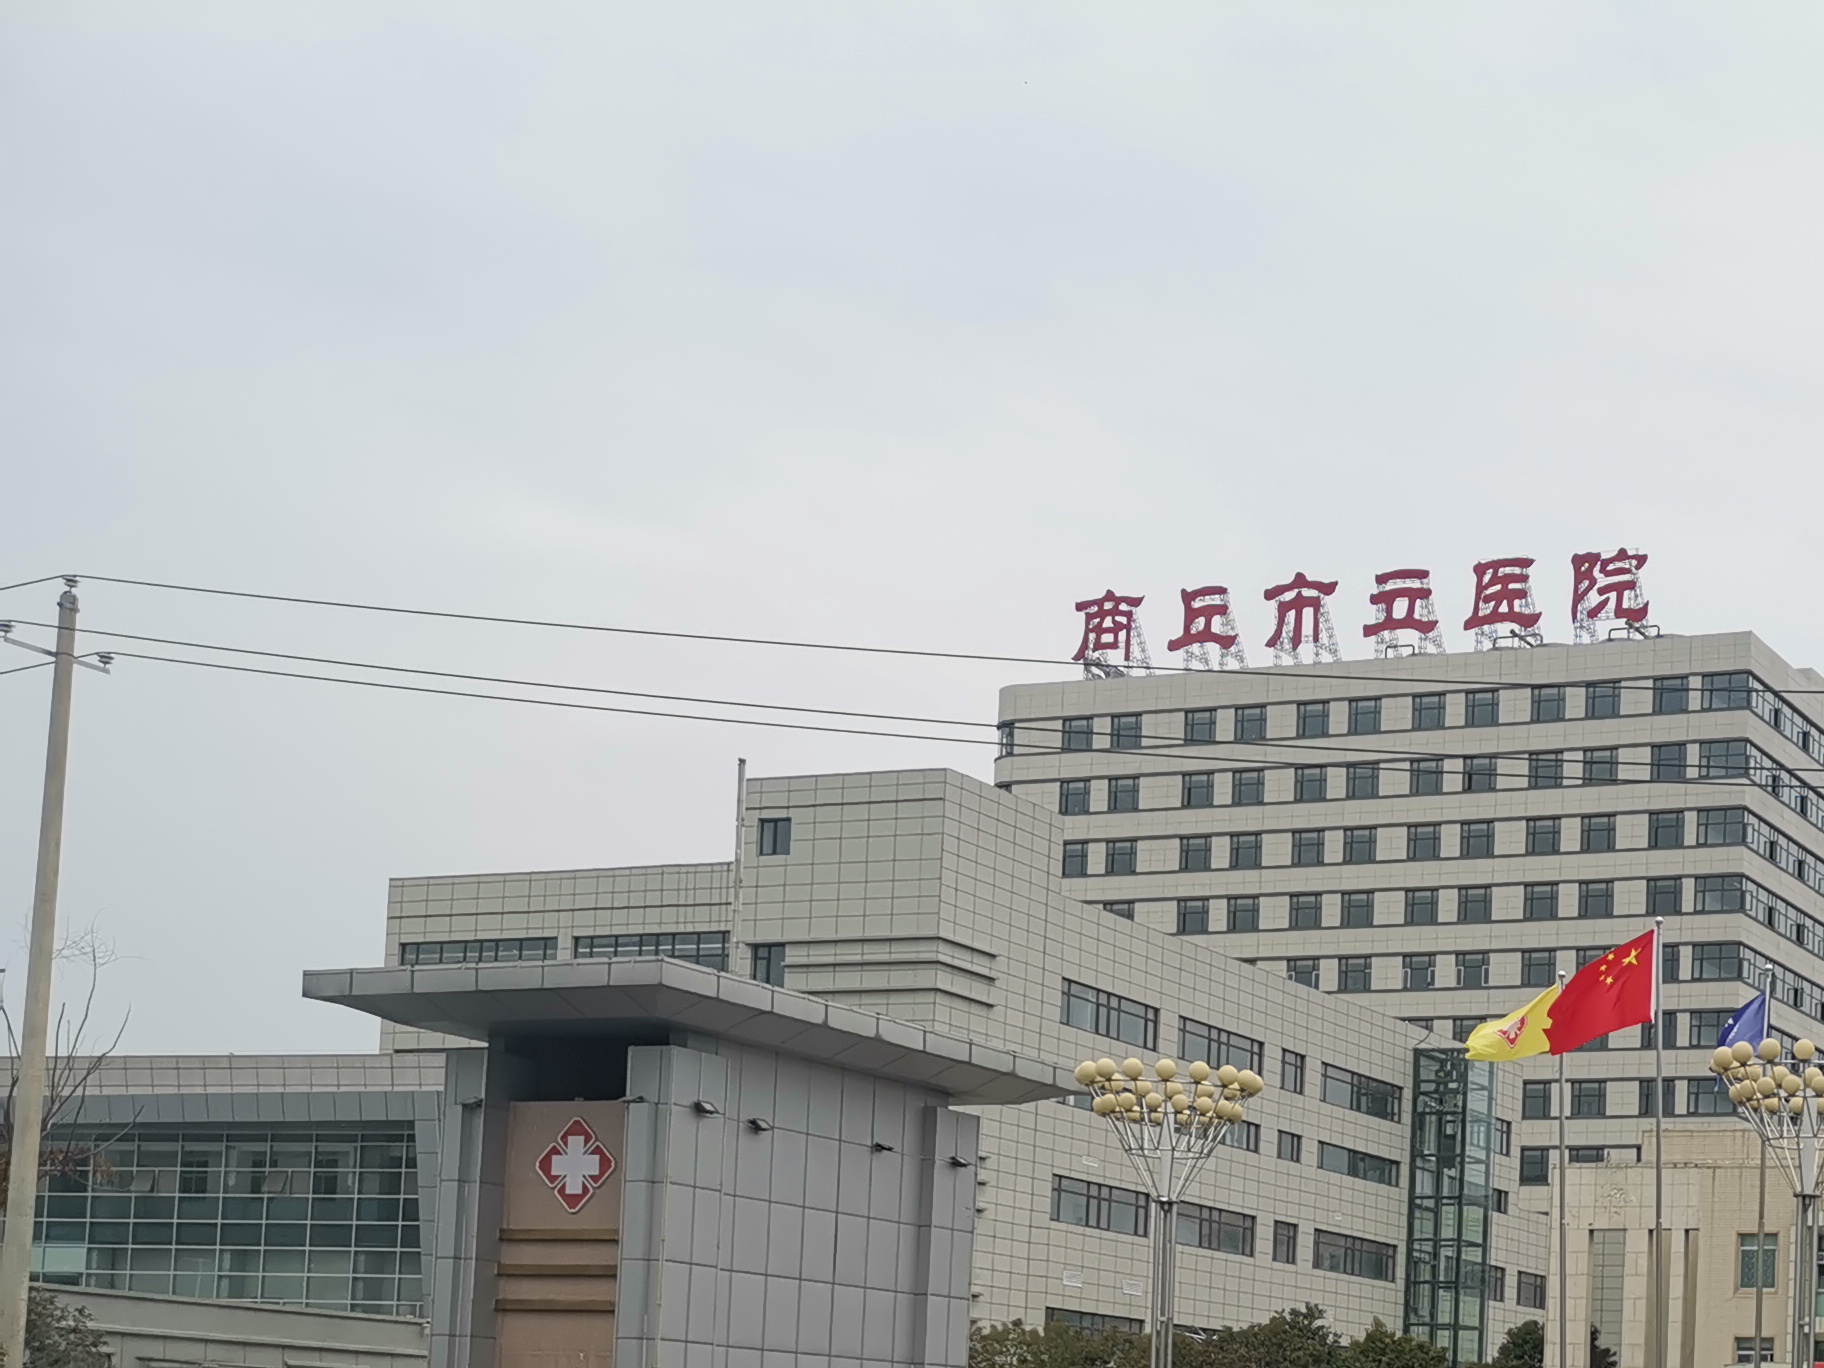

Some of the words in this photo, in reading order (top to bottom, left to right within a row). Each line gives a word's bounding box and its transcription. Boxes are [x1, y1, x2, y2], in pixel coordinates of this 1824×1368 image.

[1072, 547, 1650, 662] 商丘市立医院
